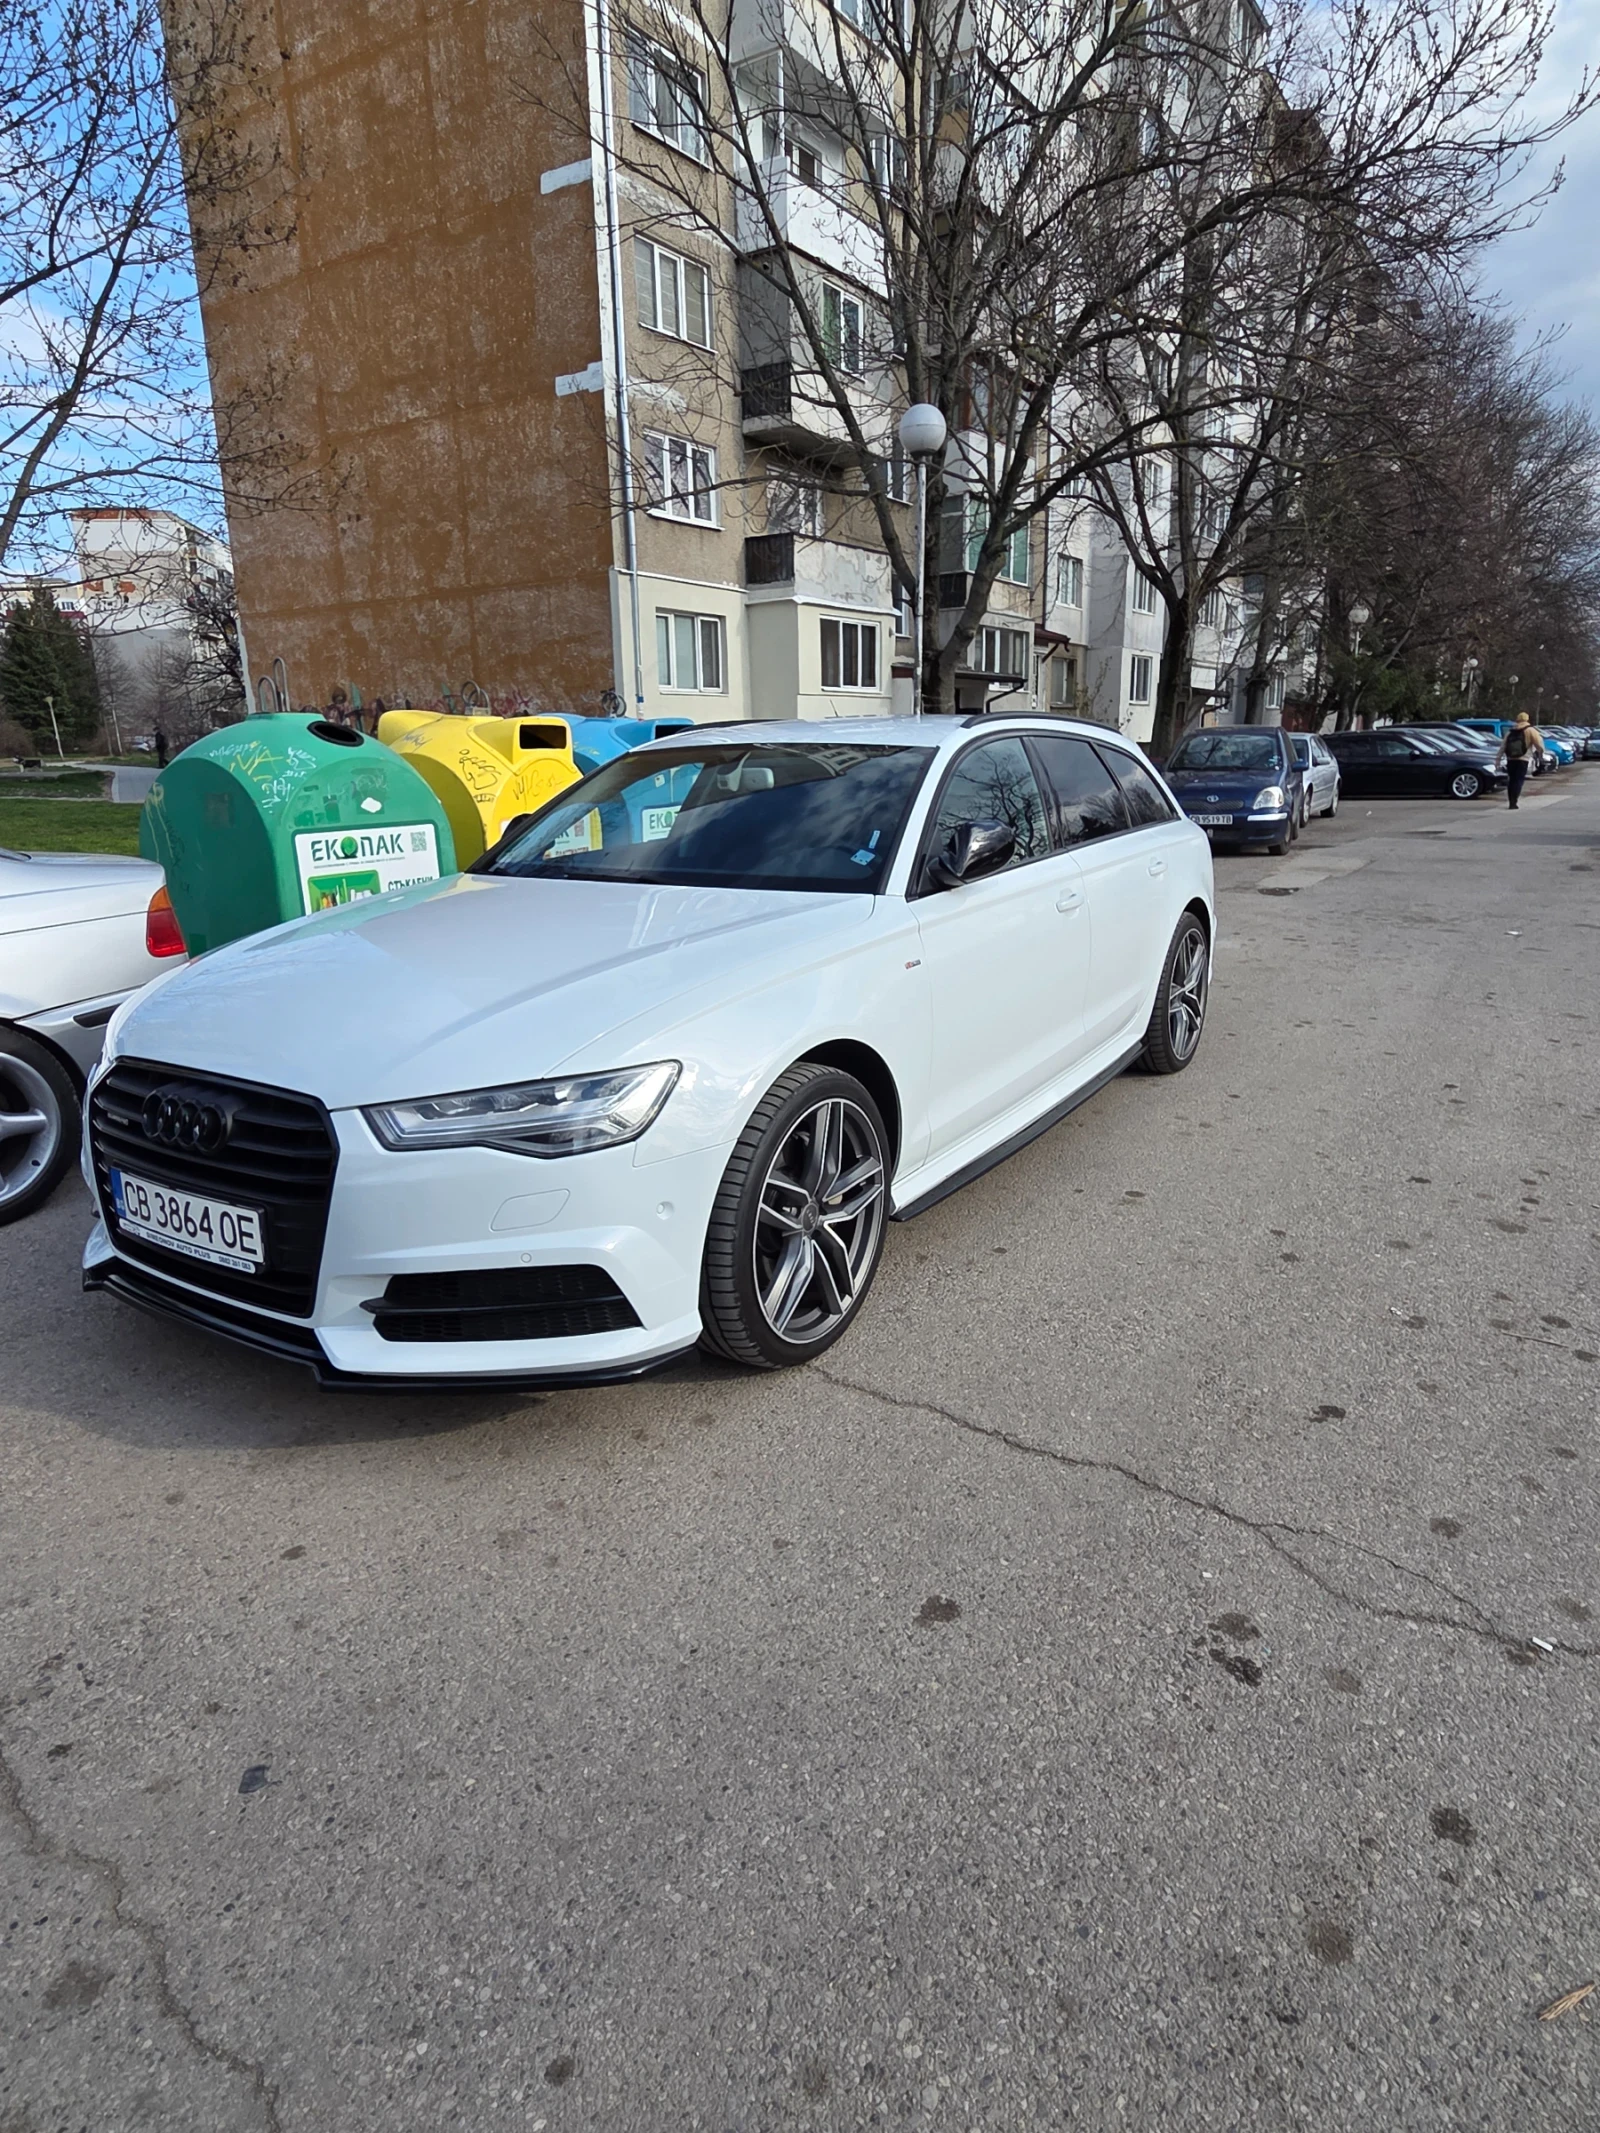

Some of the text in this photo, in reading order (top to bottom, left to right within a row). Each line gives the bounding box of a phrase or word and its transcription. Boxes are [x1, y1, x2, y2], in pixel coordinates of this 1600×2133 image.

[1201, 815, 1221, 823] 9519
[310, 832, 405, 862] ЕКОПАК
[124, 1180, 258, 1256] CB 3864 OE
[176, 1242, 193, 1255] AUTO
[193, 1248, 211, 1260] PLUS
